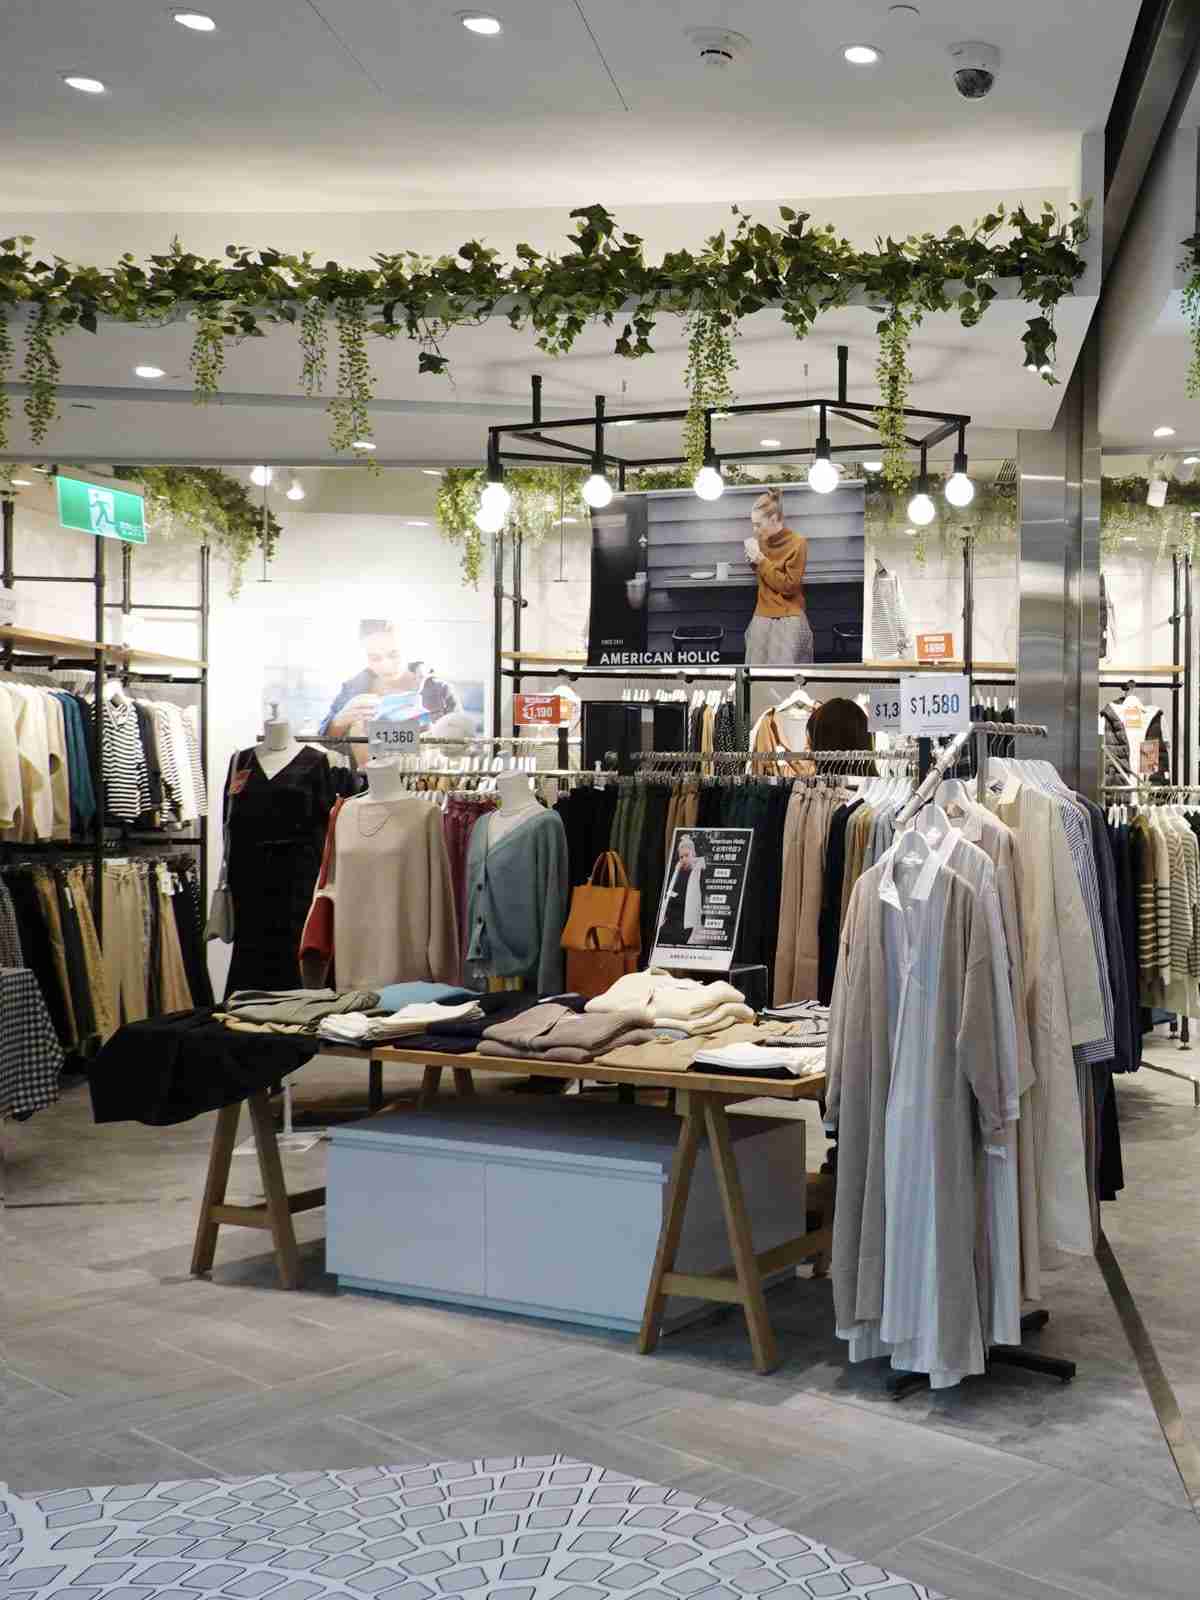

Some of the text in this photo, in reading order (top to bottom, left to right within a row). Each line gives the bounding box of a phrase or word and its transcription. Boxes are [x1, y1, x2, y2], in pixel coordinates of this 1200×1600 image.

[600, 650, 720, 665] AMERICAN HOLIC
[875, 702, 900, 719] $1,3
[910, 693, 960, 717] $1,580
[376, 730, 414, 744] $1,360
